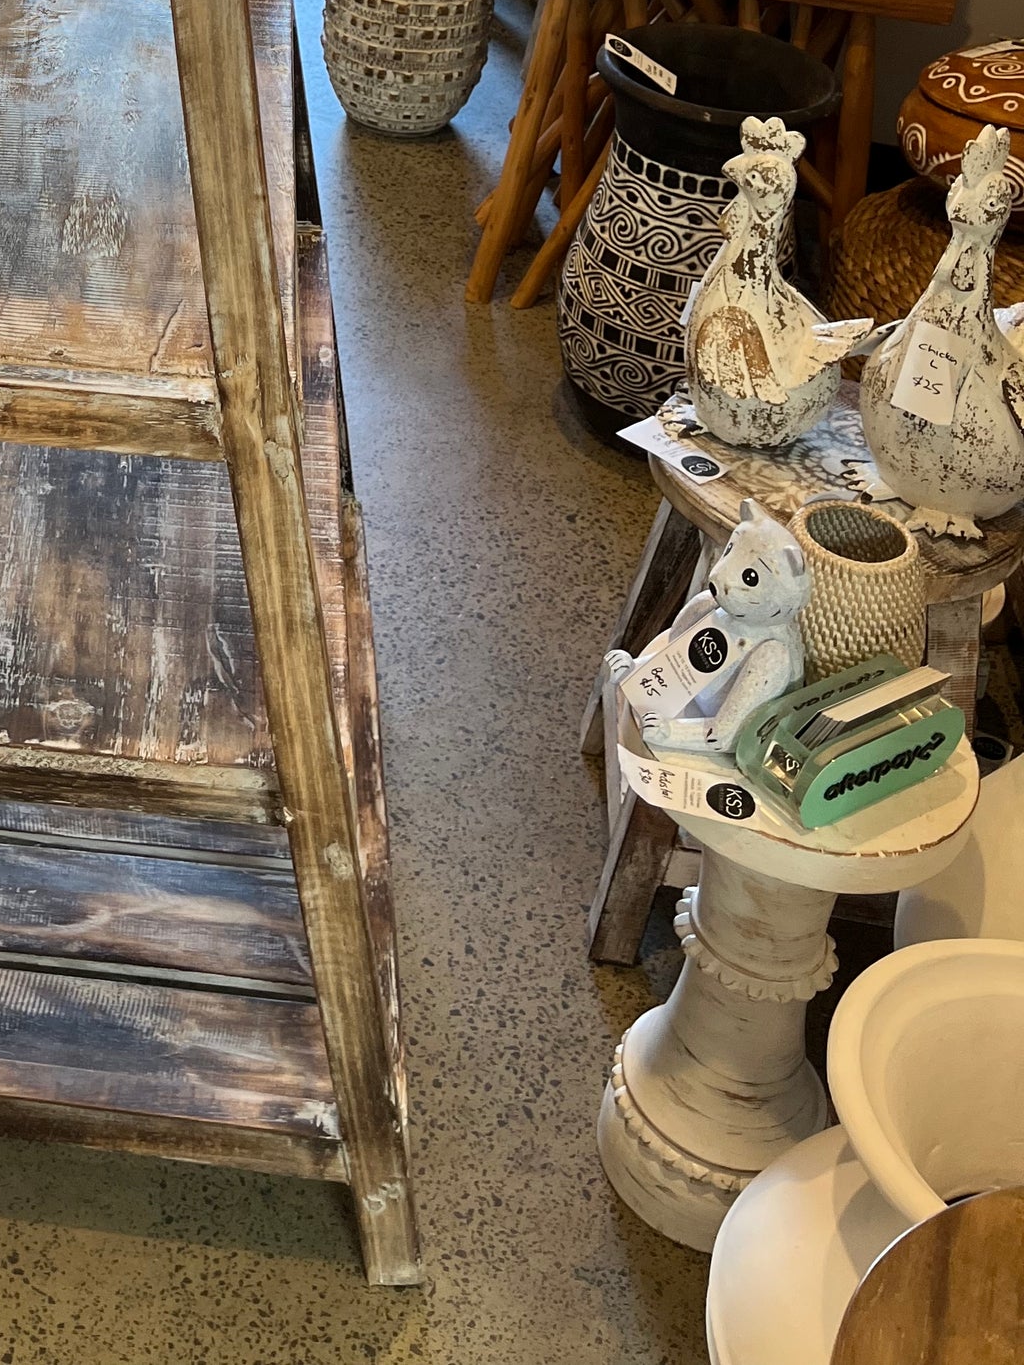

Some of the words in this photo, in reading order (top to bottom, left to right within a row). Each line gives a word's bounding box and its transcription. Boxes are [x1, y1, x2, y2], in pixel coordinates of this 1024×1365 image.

[912, 375, 944, 395] $25
[688, 461, 717, 475] KSD
[697, 631, 724, 666] KSD
[639, 677, 662, 697] $15
[650, 666, 669, 689] Bear
[823, 741, 926, 802] afterpay
[725, 787, 744, 818] KSD
